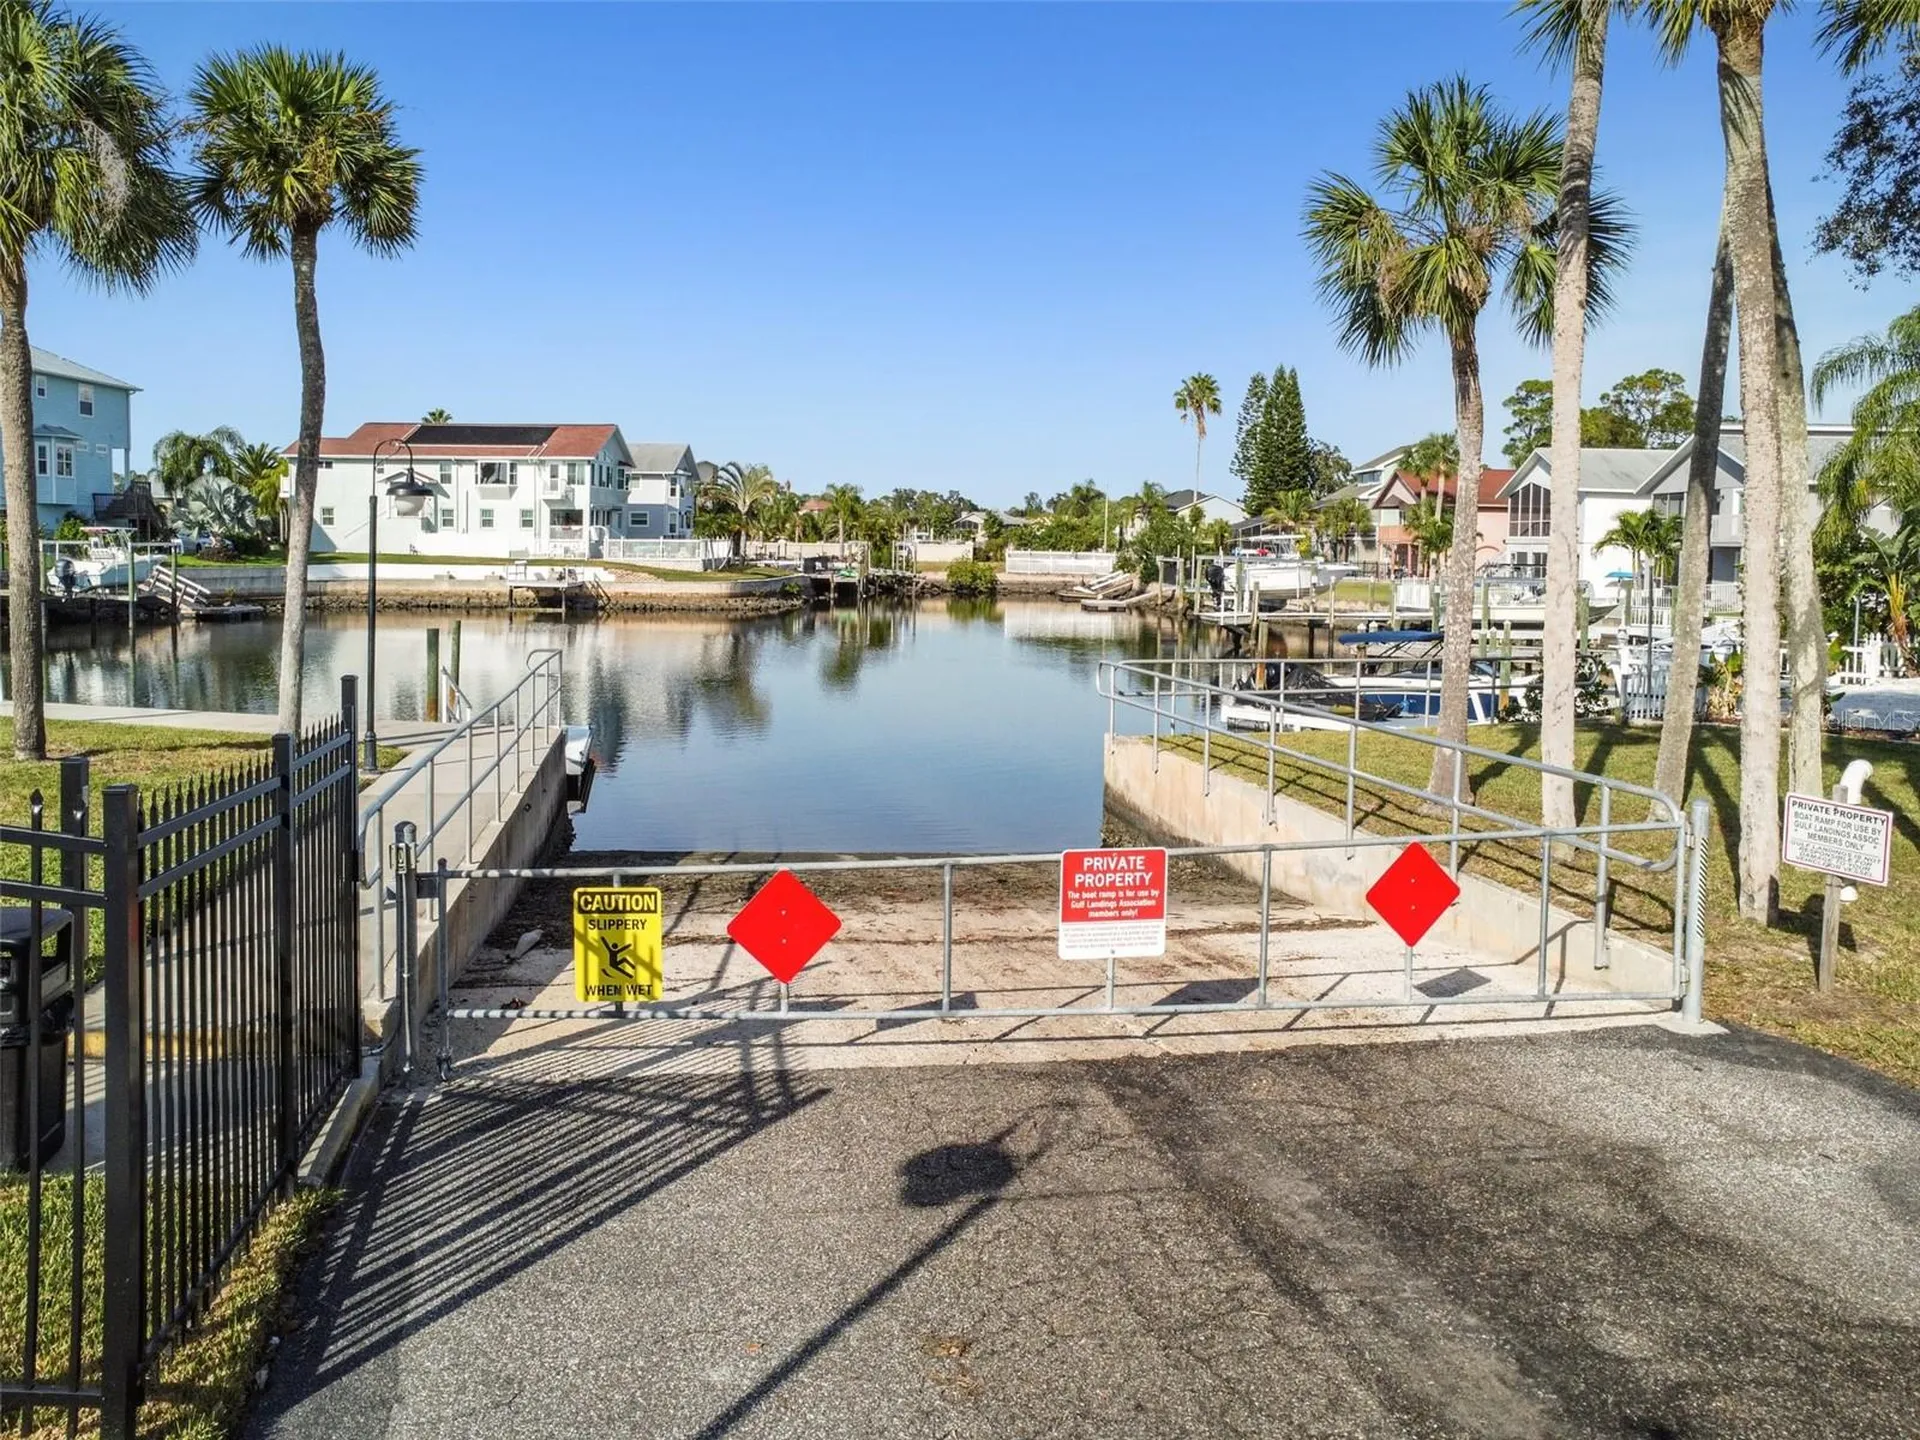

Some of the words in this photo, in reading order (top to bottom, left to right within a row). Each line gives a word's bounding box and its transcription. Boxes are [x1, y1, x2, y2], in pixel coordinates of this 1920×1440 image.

[1792, 800, 1831, 815] PRIVATE
[1833, 808, 1886, 826] PROPERTY
[1794, 812, 1812, 820] BOAT
[1814, 816, 1835, 825] RAMP
[1837, 820, 1852, 830] FOR
[1854, 824, 1869, 834] USE
[1871, 828, 1882, 836] BY
[1794, 821, 1811, 830] GULF
[1814, 824, 1851, 839] LANDINGS
[1807, 832, 1843, 846] MEMBERS
[1845, 840, 1864, 851] ONLY
[1083, 856, 1145, 871] PRIVATE
[1075, 872, 1152, 888] PROPERTY
[1068, 891, 1080, 899] The
[1082, 891, 1097, 899] boat
[1099, 891, 1116, 900] ramp
[1150, 889, 1159, 897] by
[580, 894, 656, 911] CAUTION
[1071, 900, 1086, 909] Gulf
[1087, 900, 1117, 909] Landings
[1119, 898, 1156, 907] Association
[1088, 910, 1119, 918] members
[588, 919, 647, 930] SLIPPERY
[585, 985, 622, 996] WHEN
[626, 985, 653, 995] WET
